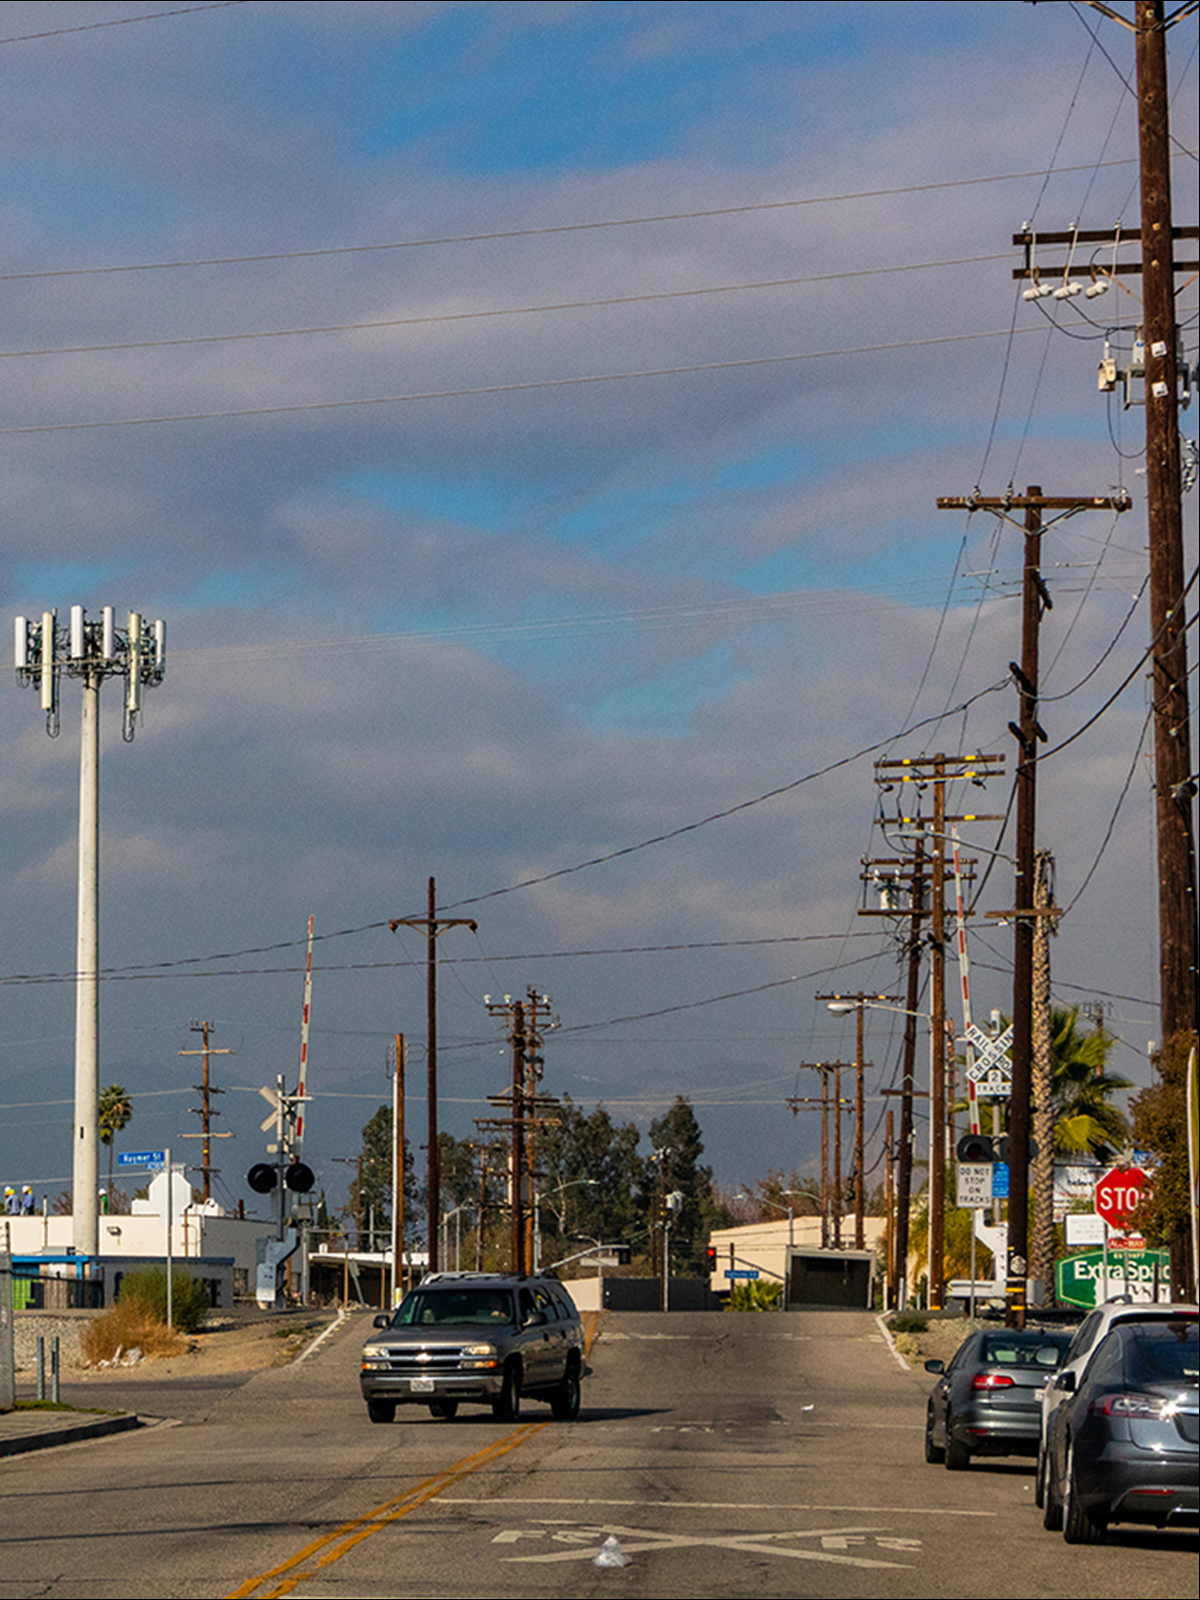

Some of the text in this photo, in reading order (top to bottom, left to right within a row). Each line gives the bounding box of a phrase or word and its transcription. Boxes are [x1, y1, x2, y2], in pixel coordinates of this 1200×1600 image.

[967, 1027, 989, 1051] RAIL
[969, 1027, 1014, 1080] CROSSIN
[991, 1072, 998, 1082] 2
[960, 1167, 971, 1175] DO
[960, 1195, 989, 1203] TRACKS
[1100, 1187, 1154, 1211] STO
